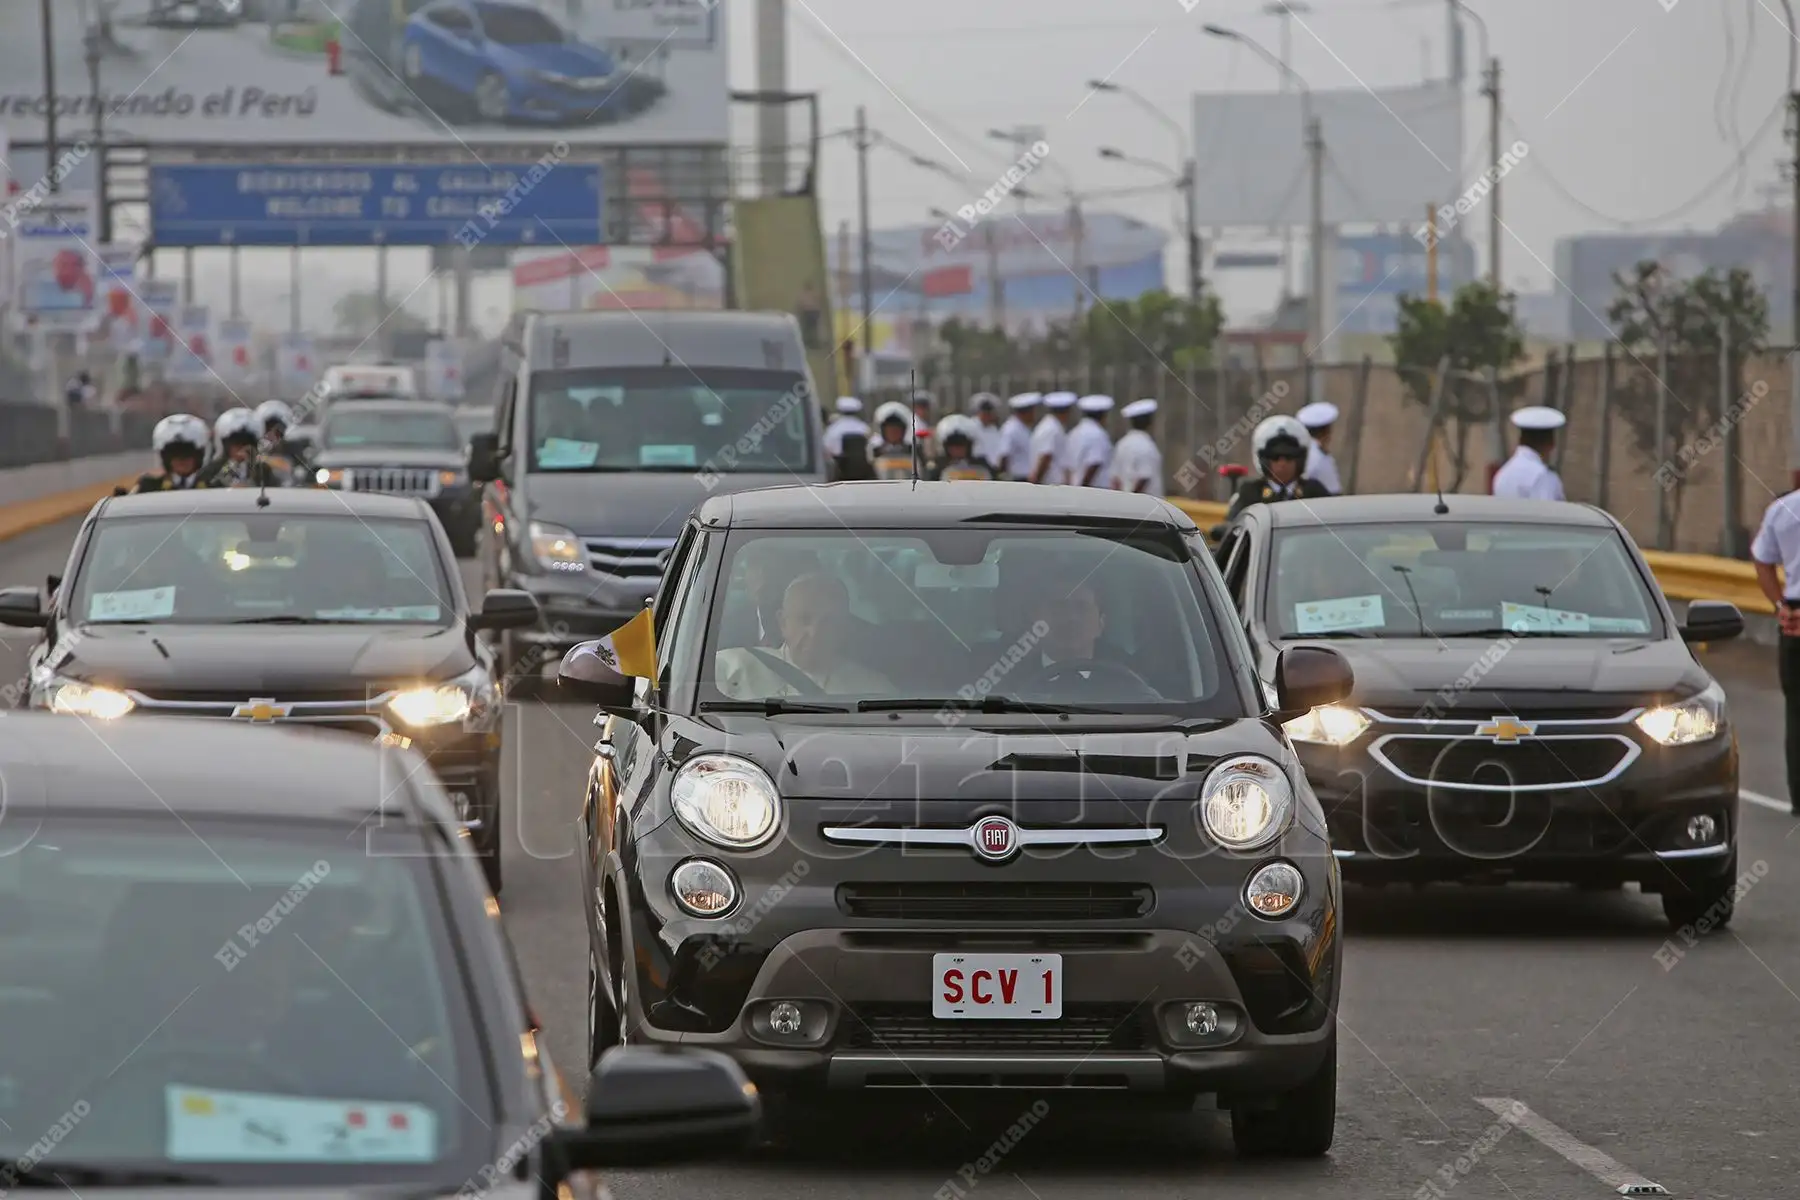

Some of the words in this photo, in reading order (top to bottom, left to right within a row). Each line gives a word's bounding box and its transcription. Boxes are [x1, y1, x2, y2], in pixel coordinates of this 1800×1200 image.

[202, 84, 235, 116] el
[238, 86, 319, 117] Perú
[266, 196, 362, 217] WELCOME
[383, 196, 410, 217] TO
[985, 829, 1008, 846] FIAT
[1042, 969, 1053, 1004] 1
